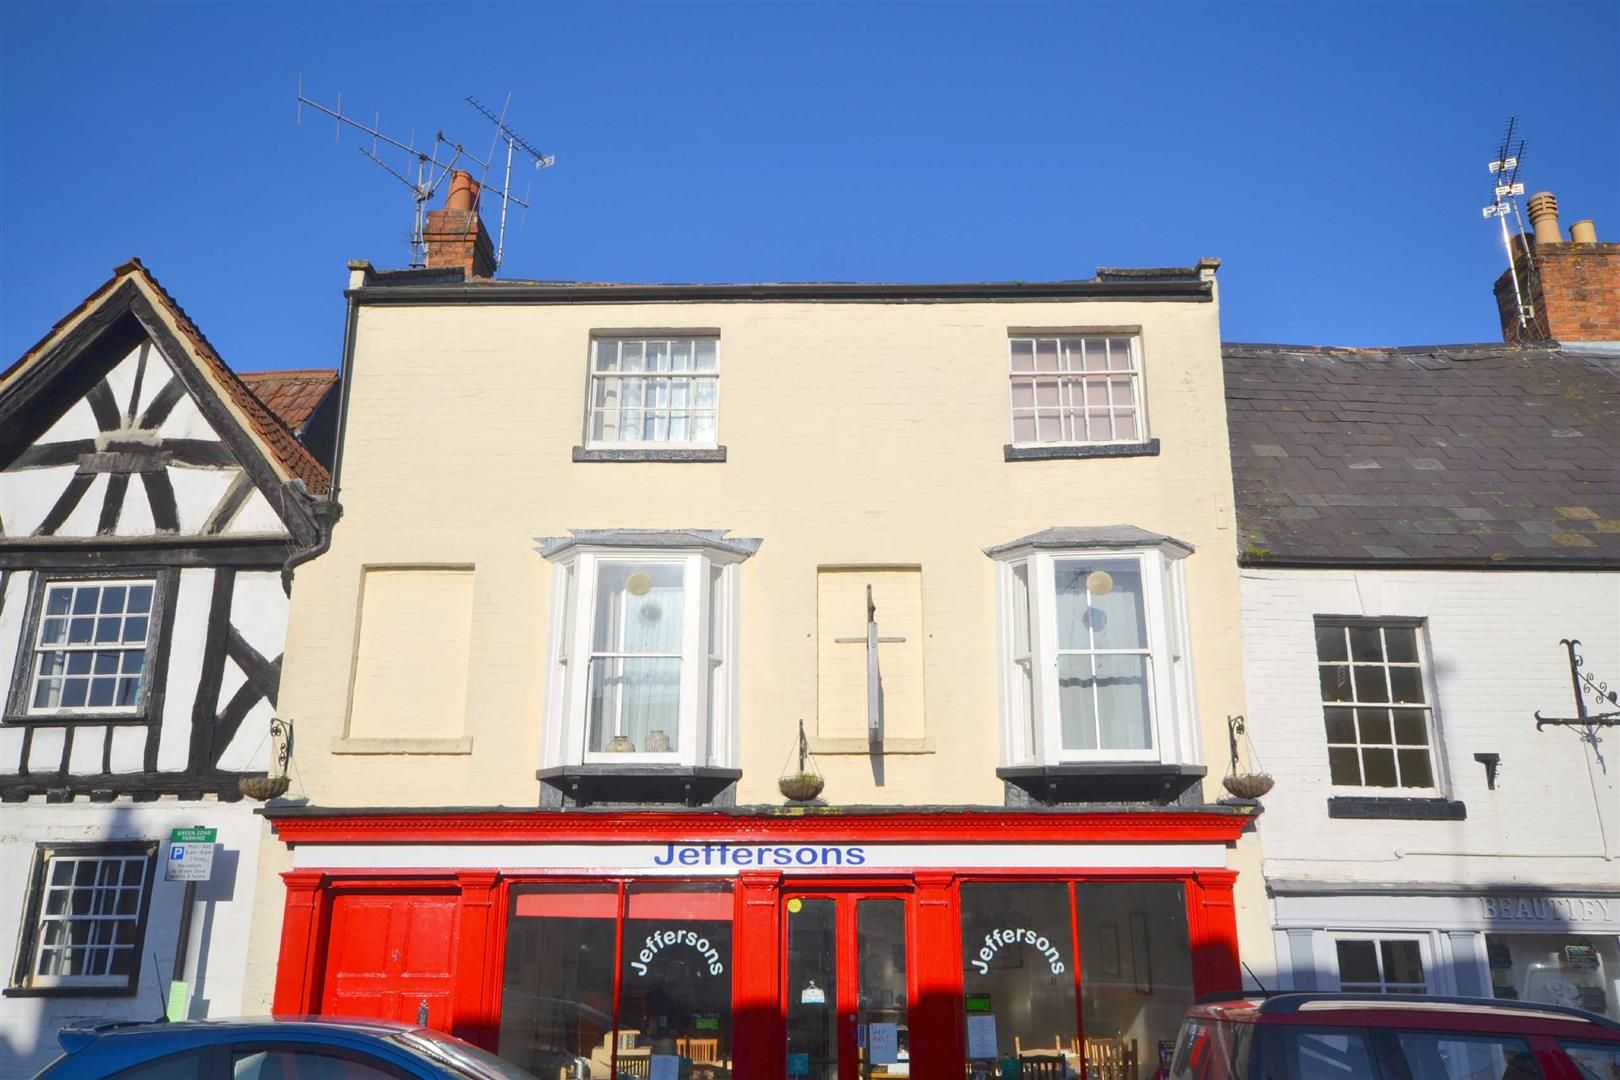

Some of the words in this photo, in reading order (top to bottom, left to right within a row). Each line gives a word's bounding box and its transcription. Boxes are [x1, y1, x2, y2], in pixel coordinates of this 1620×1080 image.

[173, 847, 183, 858] P
[654, 841, 865, 866] Jeffersons
[1480, 897, 1612, 922] BEAUTIFY
[631, 929, 724, 976] Jeffersons
[971, 928, 1065, 975] Jeffersons
